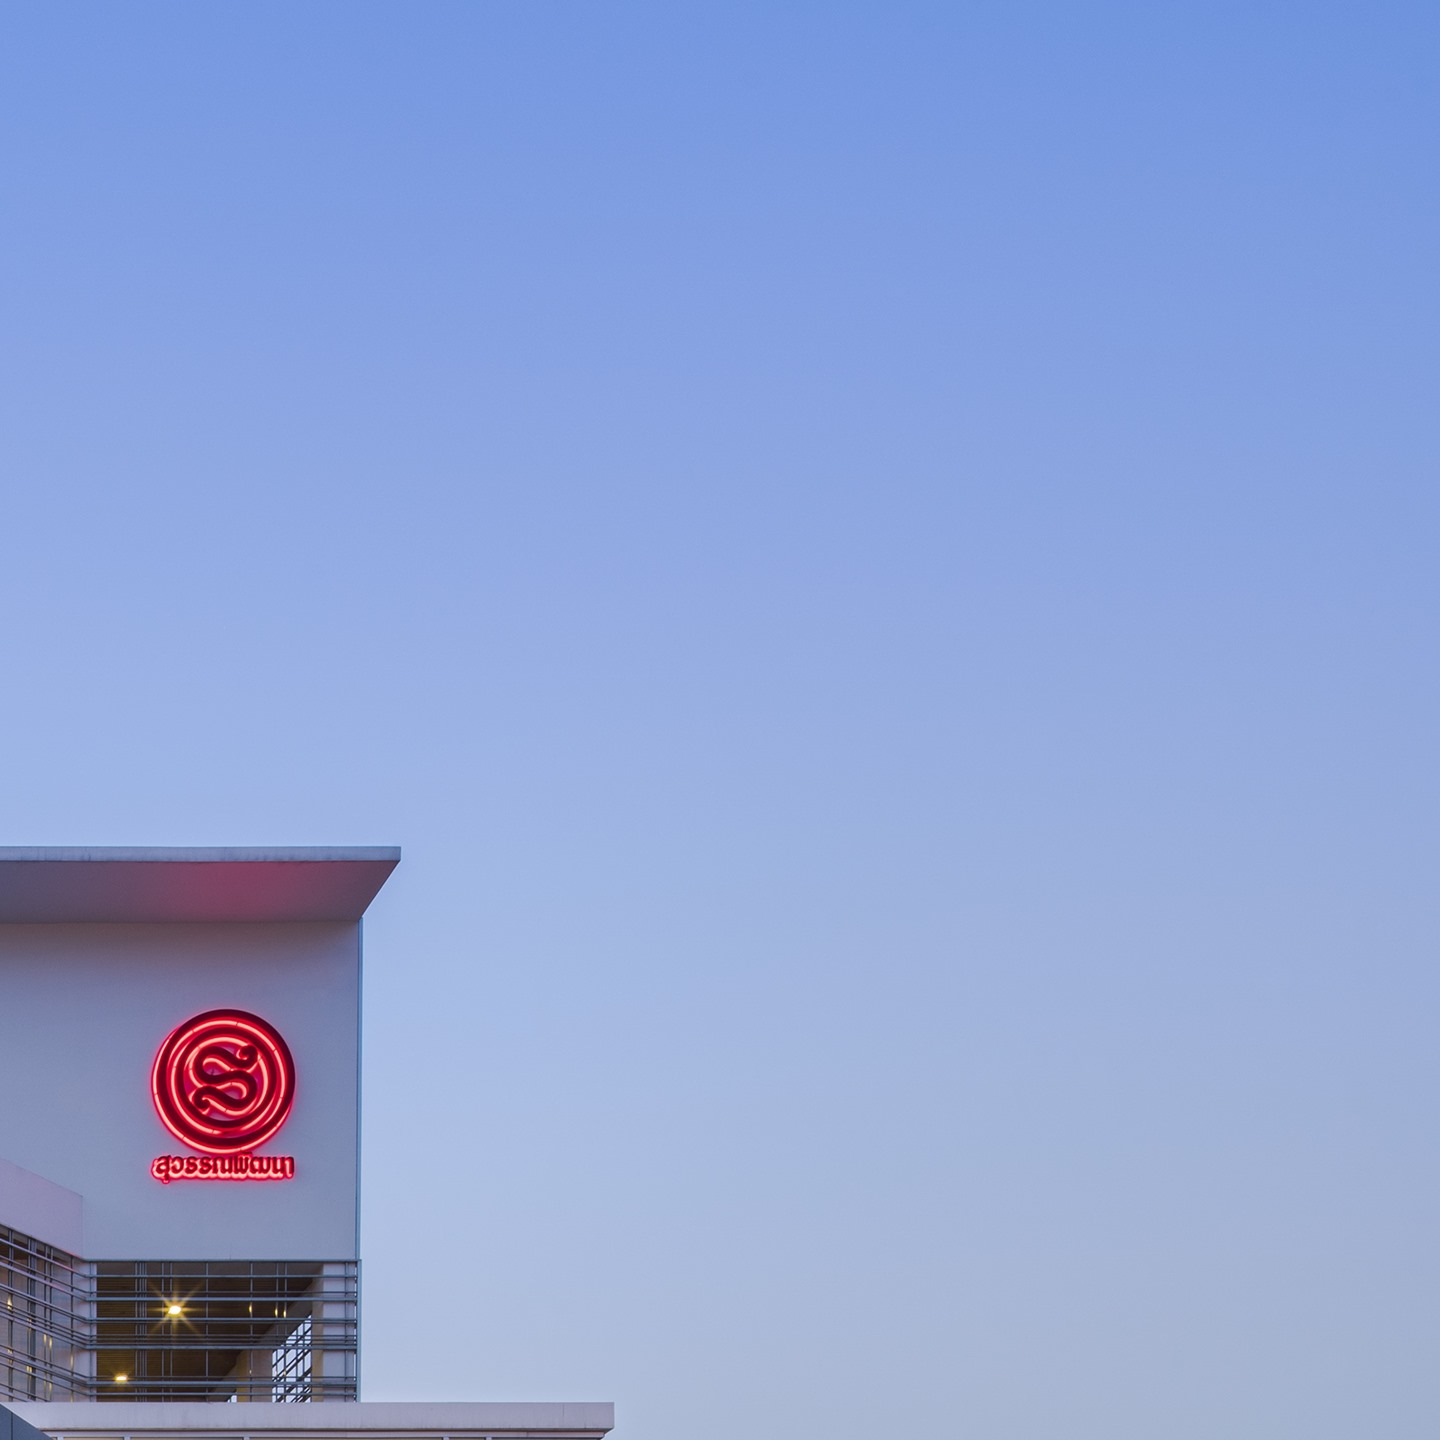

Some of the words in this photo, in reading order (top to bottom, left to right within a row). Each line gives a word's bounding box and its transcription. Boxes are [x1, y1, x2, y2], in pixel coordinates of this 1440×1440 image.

[152, 1151, 295, 1184] สุวรรณพัฒนา
